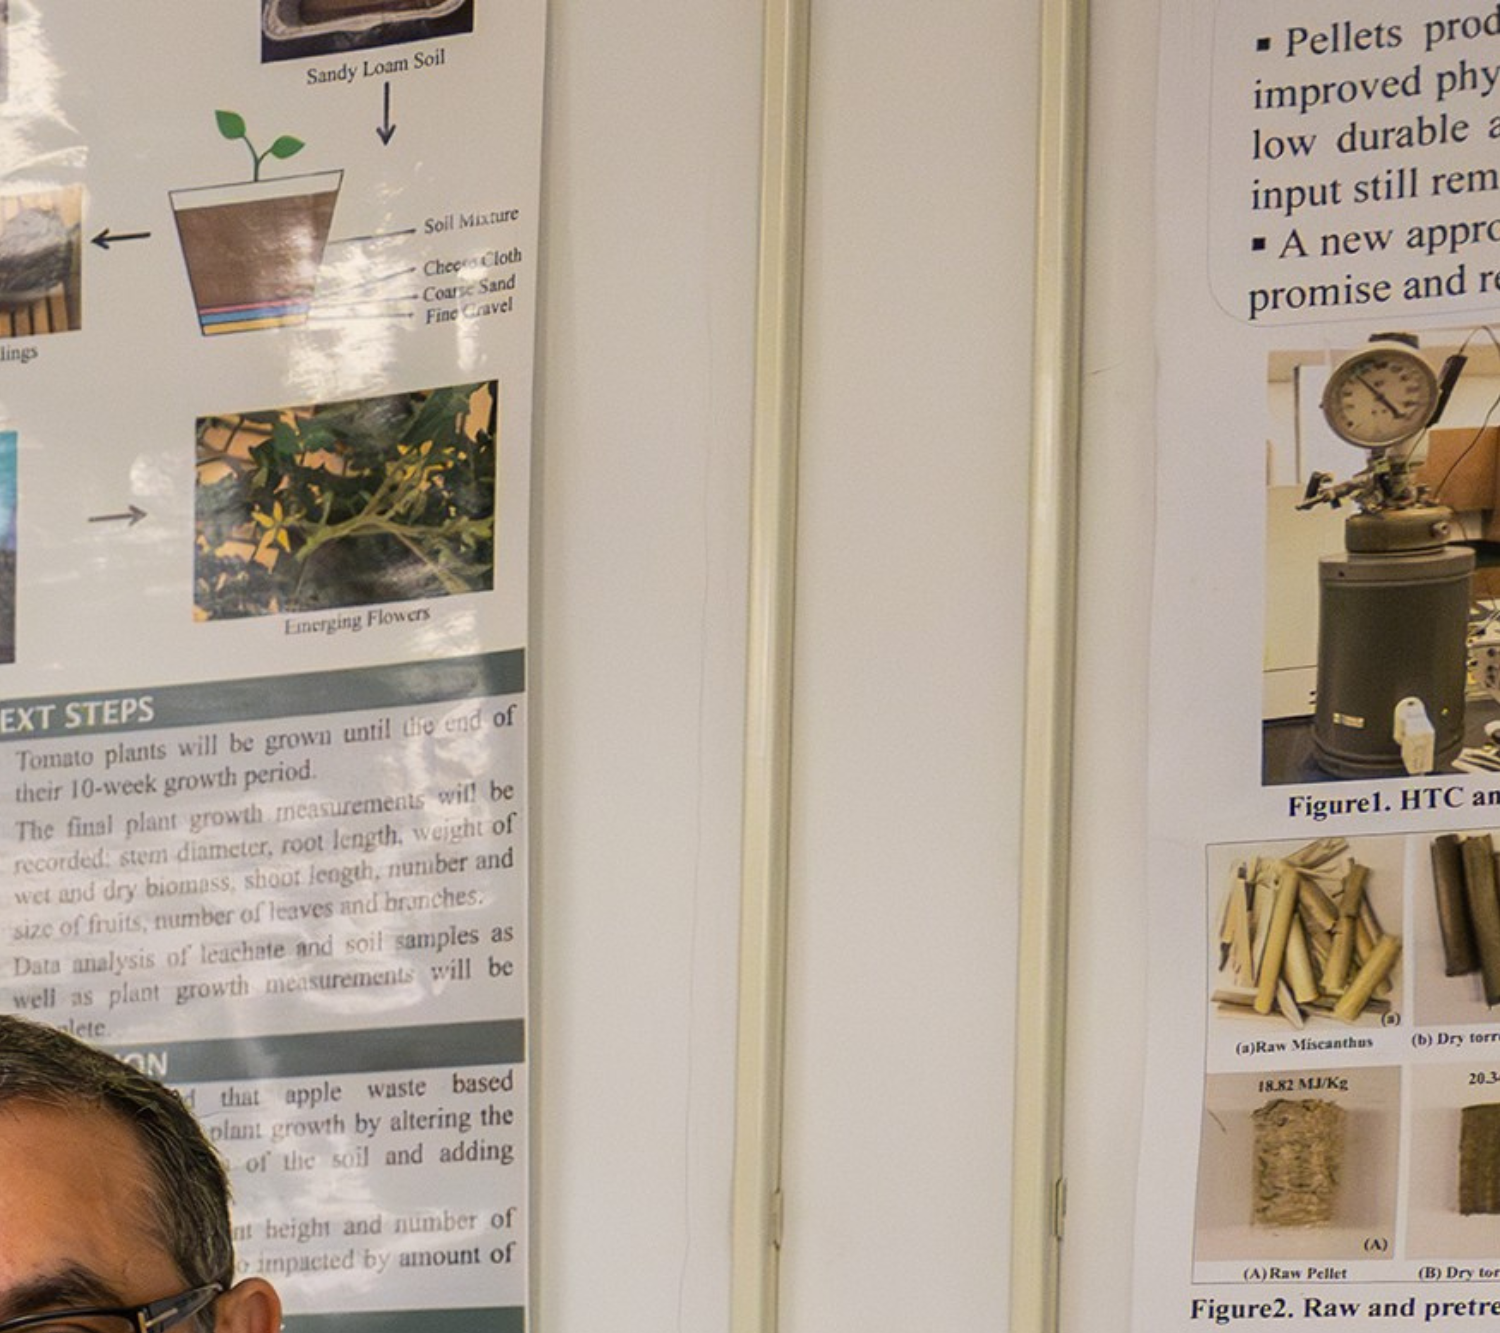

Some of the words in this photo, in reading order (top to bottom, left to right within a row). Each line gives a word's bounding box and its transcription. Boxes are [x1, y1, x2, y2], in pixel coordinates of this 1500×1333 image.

[1286, 21, 1403, 57] Pellets
[306, 63, 358, 86] Sandy
[363, 57, 409, 78] Loam
[413, 48, 446, 68] Soil
[1253, 65, 1421, 115] improved
[1253, 130, 1317, 159] low
[1337, 114, 1469, 153] durable
[1252, 180, 1342, 217] input
[1354, 168, 1418, 203] still
[1279, 229, 1308, 259] A
[1321, 229, 1393, 256] new
[1248, 275, 1391, 320] promise
[1403, 264, 1466, 301] and
[283, 614, 363, 637] Emerging
[369, 605, 432, 630] Flowers
[66, 697, 155, 729] STEPS
[15, 749, 93, 773] Tomato
[104, 742, 167, 768] plants
[179, 734, 218, 758] will
[229, 732, 255, 753] be
[264, 728, 333, 756] grown
[343, 720, 391, 743] until
[492, 705, 517, 729] of
[15, 780, 62, 804] their
[71, 771, 157, 801] 10-week
[163, 765, 238, 795] growth
[244, 760, 318, 791] period.
[1289, 792, 1391, 821] Figure1.
[1401, 787, 1464, 810] HTC
[1381, 1013, 1400, 1026] (a)
[1292, 1037, 1373, 1051] Miscanthus
[1412, 1033, 1432, 1048] (b)
[1438, 1032, 1463, 1047] Dry
[221, 1087, 260, 1107] that
[285, 1082, 342, 1109] apple
[368, 1078, 427, 1099] waste
[452, 1070, 514, 1093] based
[1258, 1080, 1294, 1092] 18.82
[1299, 1078, 1348, 1092] MJ/Kg
[211, 1123, 262, 1145] plant
[271, 1114, 345, 1141] growth
[355, 1112, 381, 1137] by
[390, 1108, 471, 1134] altering
[481, 1105, 514, 1126] the
[246, 1150, 271, 1173] of
[332, 1147, 369, 1168] soil
[385, 1143, 423, 1165] and
[440, 1139, 514, 1165] adding
[1364, 1239, 1388, 1251] (A)
[1308, 1267, 1347, 1279] Pellet
[1419, 1267, 1441, 1280] (B)
[1446, 1267, 1472, 1281] Dry
[1190, 1299, 1294, 1325] Figure2.
[1304, 1299, 1360, 1318] Raw
[1368, 1298, 1415, 1318] and
